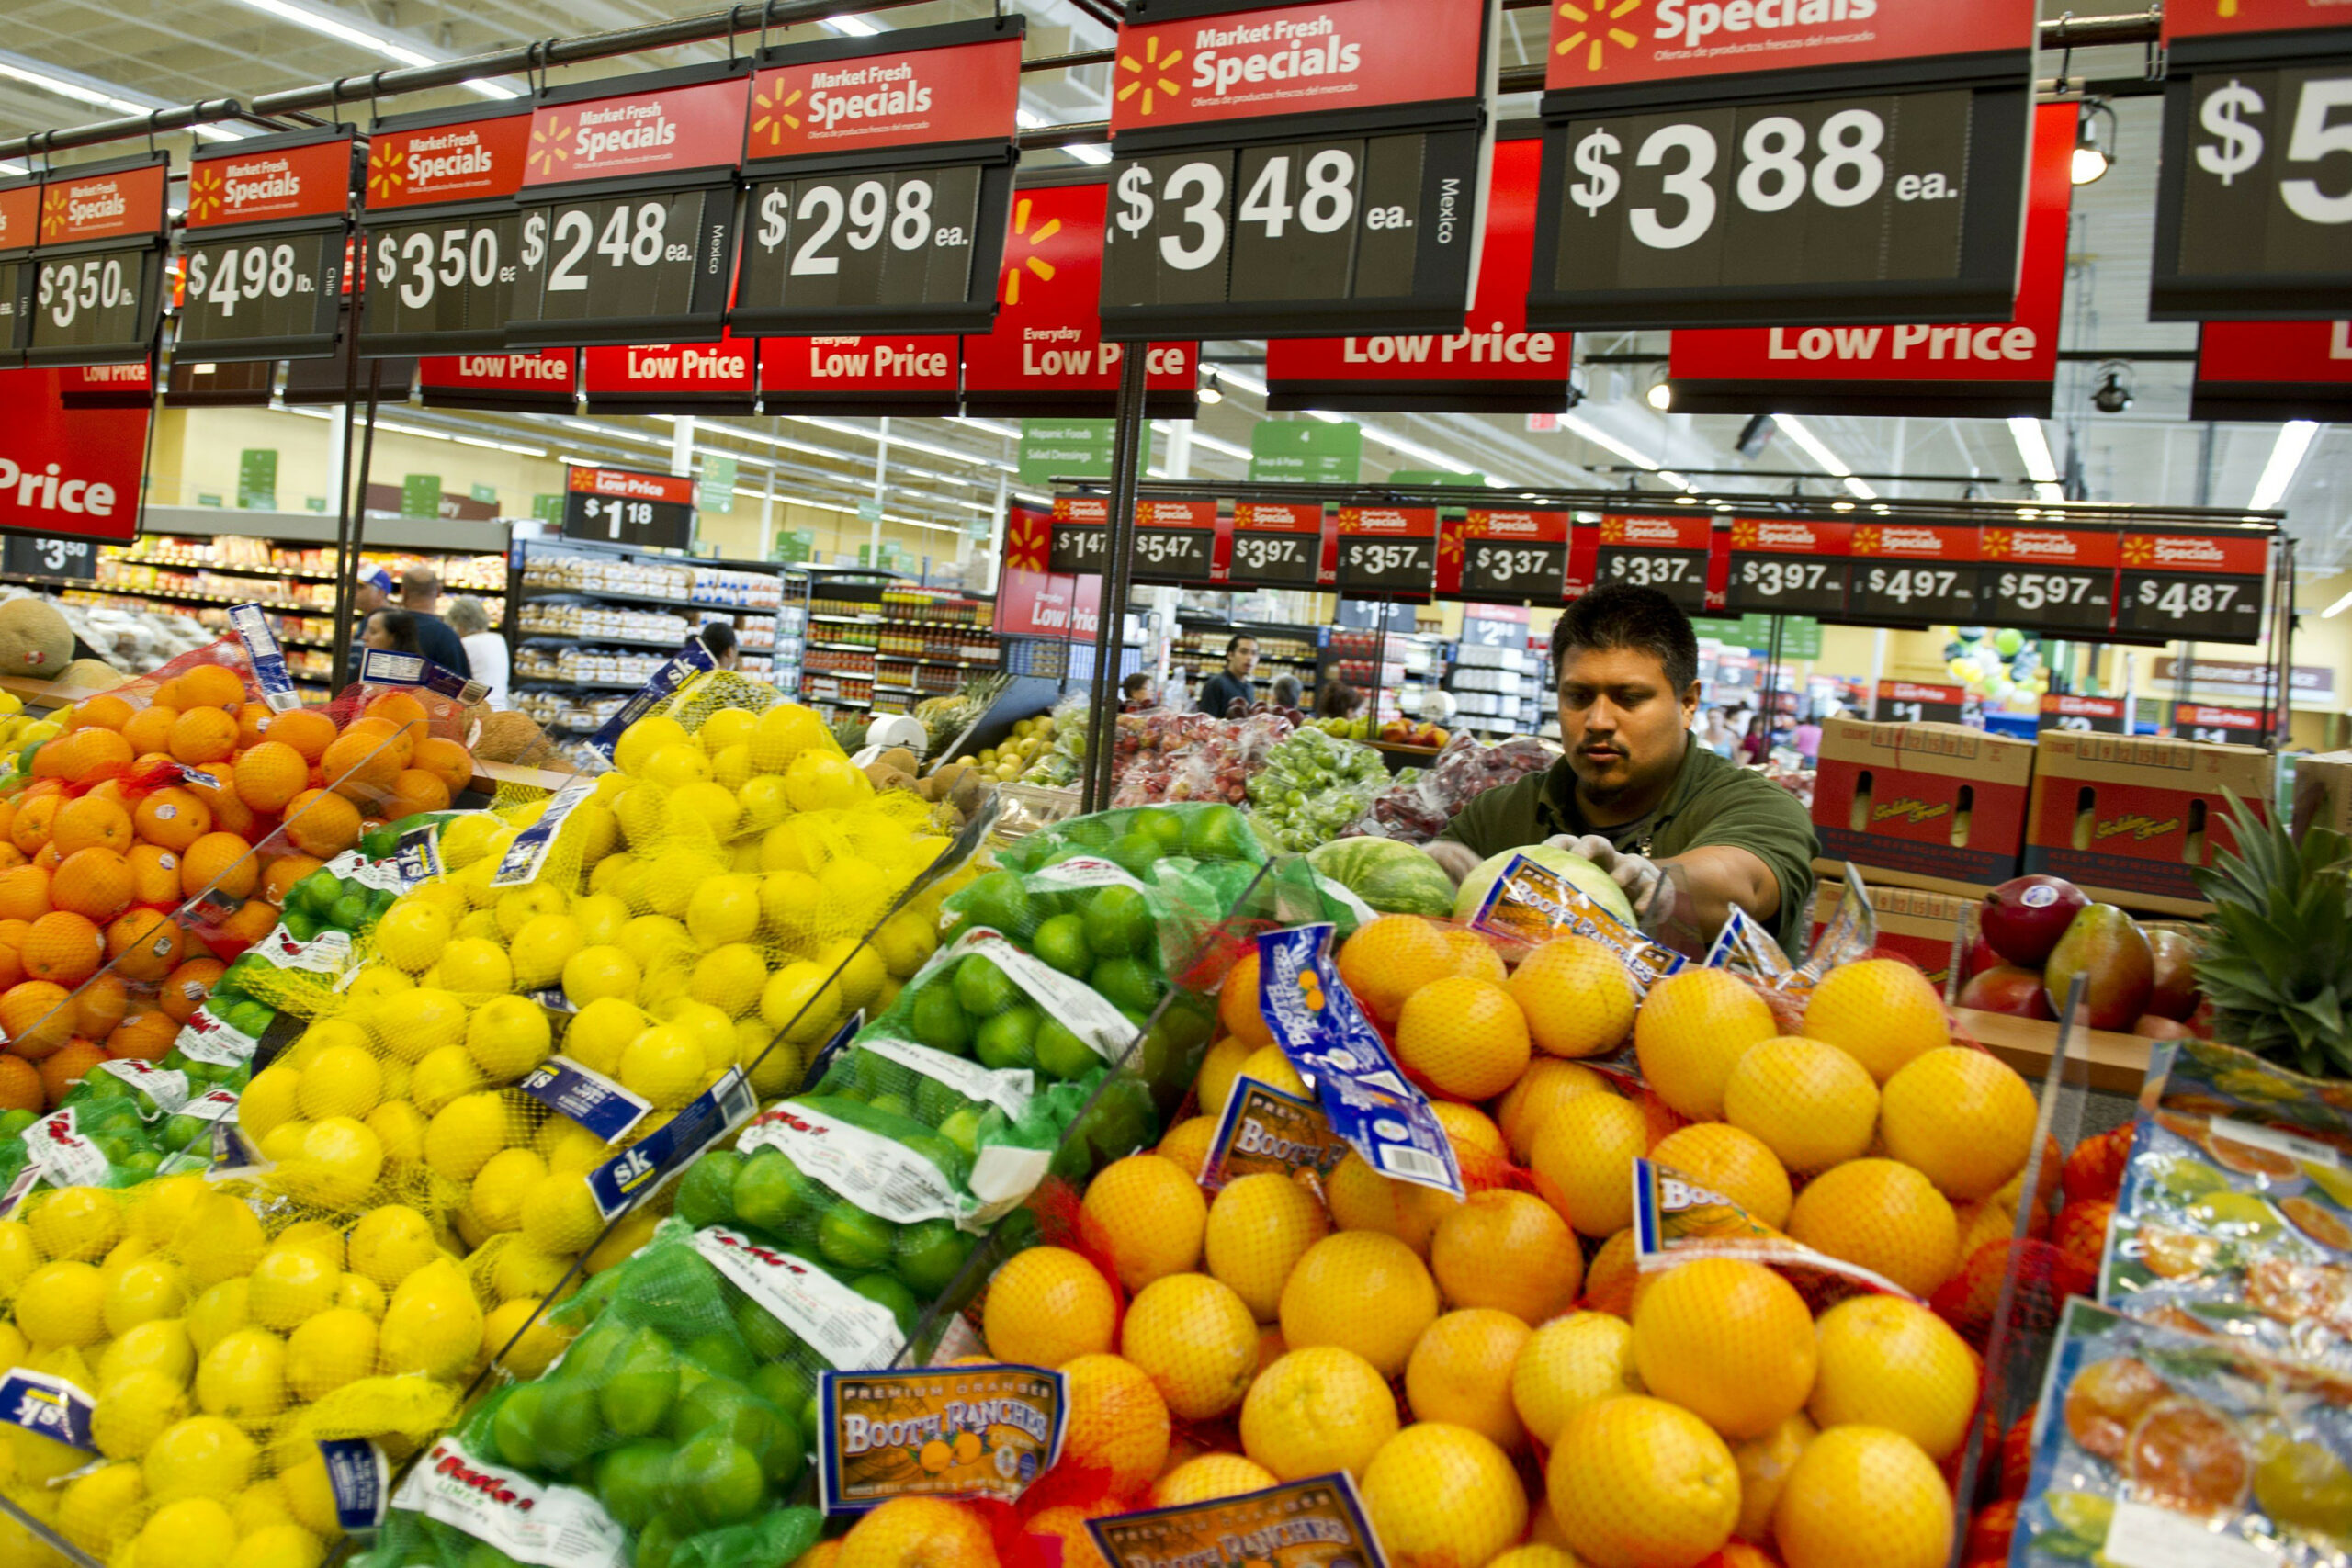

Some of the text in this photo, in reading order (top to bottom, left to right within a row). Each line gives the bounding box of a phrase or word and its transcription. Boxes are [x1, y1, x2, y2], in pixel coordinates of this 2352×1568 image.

[1195, 15, 1333, 50] Market Fresh
[1654, 0, 1877, 47] Specials
[1654, 31, 1875, 61] Ofertas de productos frescos del mercado
[811, 62, 912, 89] Market Fresh
[1192, 34, 1361, 95] Specials
[808, 79, 932, 130] Specials
[1191, 82, 1359, 107] Ofertas de productos frescos del mercado
[579, 101, 662, 126] Market Fresh
[408, 130, 478, 152] Market Fresh
[574, 117, 676, 161] Specials
[226, 158, 289, 178] Market Fresh
[407, 144, 492, 186] Specials
[1570, 108, 1958, 249] $388 ea.
[223, 171, 300, 209] Specials
[68, 193, 126, 226] Specials
[1116, 149, 1413, 270] $348 ea.
[1437, 178, 1460, 244] Mexico
[758, 179, 968, 275] $298 ea.
[521, 202, 693, 292] $248 ea.
[708, 224, 724, 274] Mexico
[188, 244, 295, 317] $498
[296, 274, 315, 293] lb.
[325, 267, 336, 296] Chile
[376, 228, 498, 309] $350
[38, 260, 121, 328] $350
[1023, 326, 1081, 344] Everyday
[1344, 321, 1555, 363] Low Price
[1769, 323, 2036, 361] Low Price
[460, 354, 567, 380] Low Price
[628, 348, 745, 379] Low Price
[811, 344, 947, 378] Low Price
[1023, 342, 1185, 376] Low Pce
[1299, 431, 1310, 443] 4
[597, 477, 665, 497] Low Price
[584, 498, 652, 539] $118
[1136, 536, 1193, 562] $547
[1236, 538, 1296, 568] $397
[1350, 546, 1418, 574] $357
[1476, 548, 1548, 581] $337
[1743, 561, 1827, 595] $397
[1869, 569, 1958, 603] $497
[1999, 573, 2092, 610] $597
[1031, 601, 1099, 632] Low Pric
[2139, 580, 2239, 619] $487
[2097, 857, 2192, 876] REFRIGER
[1235, 1116, 1323, 1168] BOOTH
[614, 1148, 654, 1186] sk
[843, 1381, 1049, 1401] PREMIUM ORANGES
[843, 1414, 942, 1454] BOOTH
[944, 1398, 1048, 1443] RANCHES
